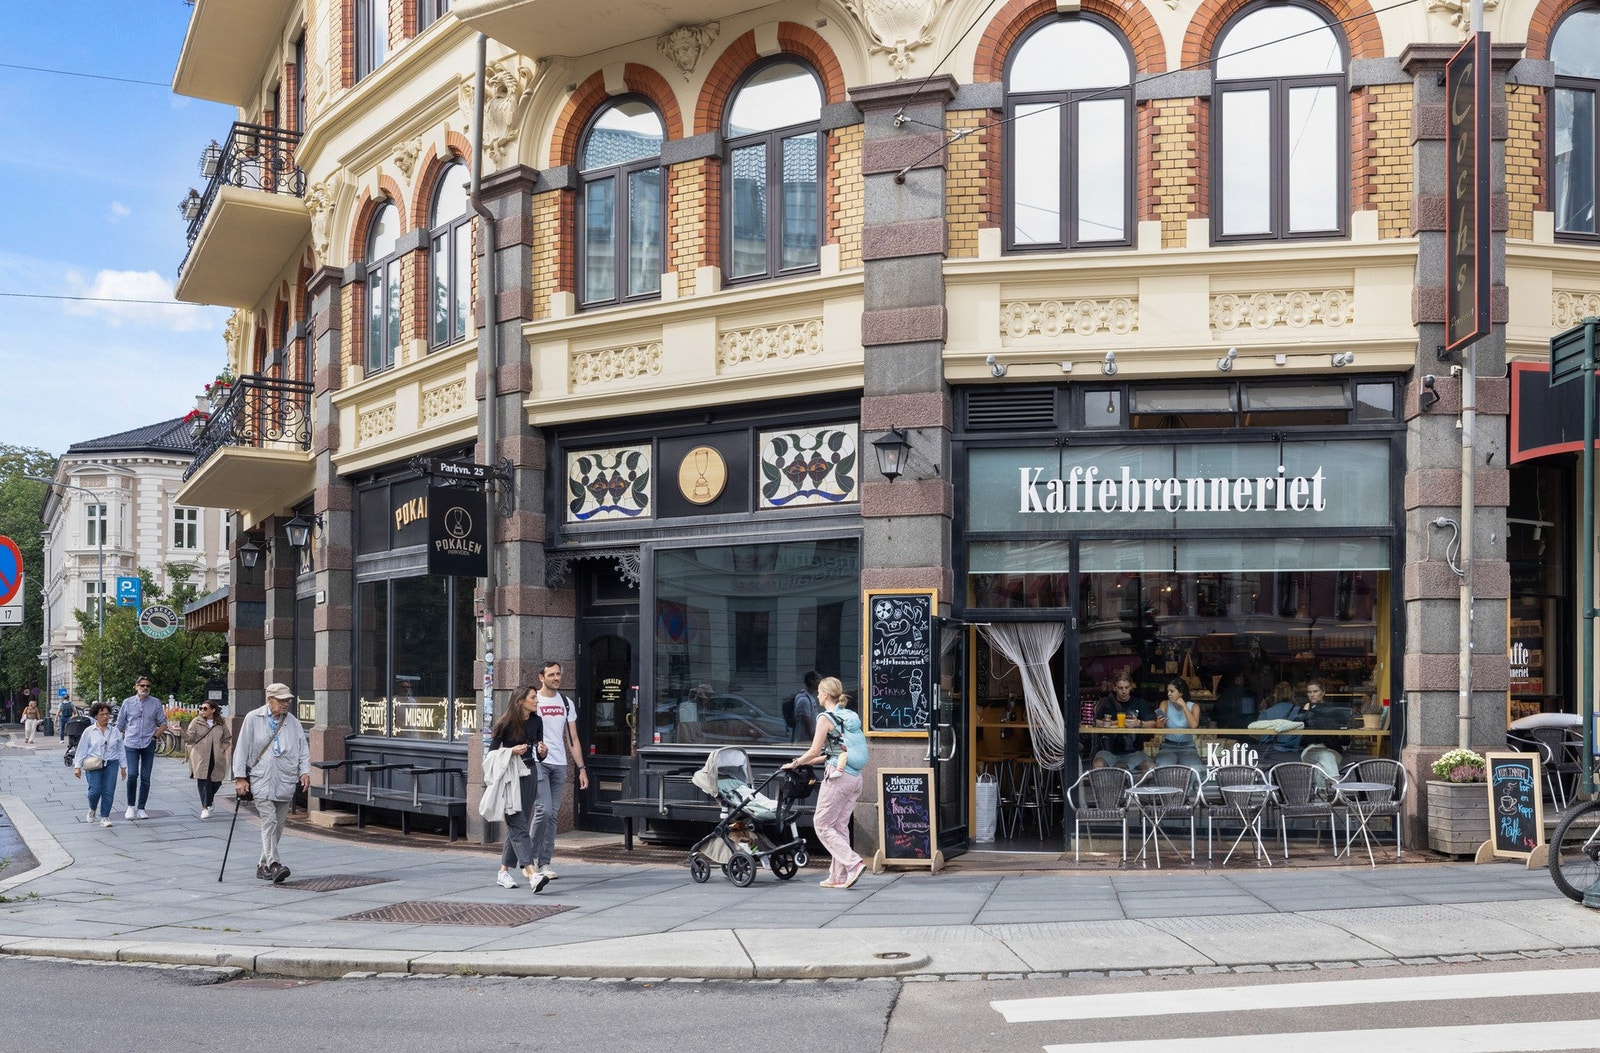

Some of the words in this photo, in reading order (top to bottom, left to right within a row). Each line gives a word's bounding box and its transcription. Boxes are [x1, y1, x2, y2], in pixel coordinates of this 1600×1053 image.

[1452, 62, 1473, 291] Cochs
[440, 462, 471, 475] Parkvn.
[474, 467, 484, 476] 25
[1018, 465, 1327, 513] Kaffebrenneriet
[435, 538, 482, 555] POKALEN
[5, 610, 12, 619] 17
[143, 607, 175, 620] ESPRESSO
[146, 628, 172, 637] HOUSE
[872, 698, 892, 710] Fra
[363, 706, 385, 725] SPORT
[404, 708, 434, 727] MUSIKK
[1206, 742, 1259, 767] Kaffe
[891, 775, 923, 785] MÅNEDENS
[899, 784, 919, 792] KAFFE
[1500, 816, 1522, 844] Kaffe
